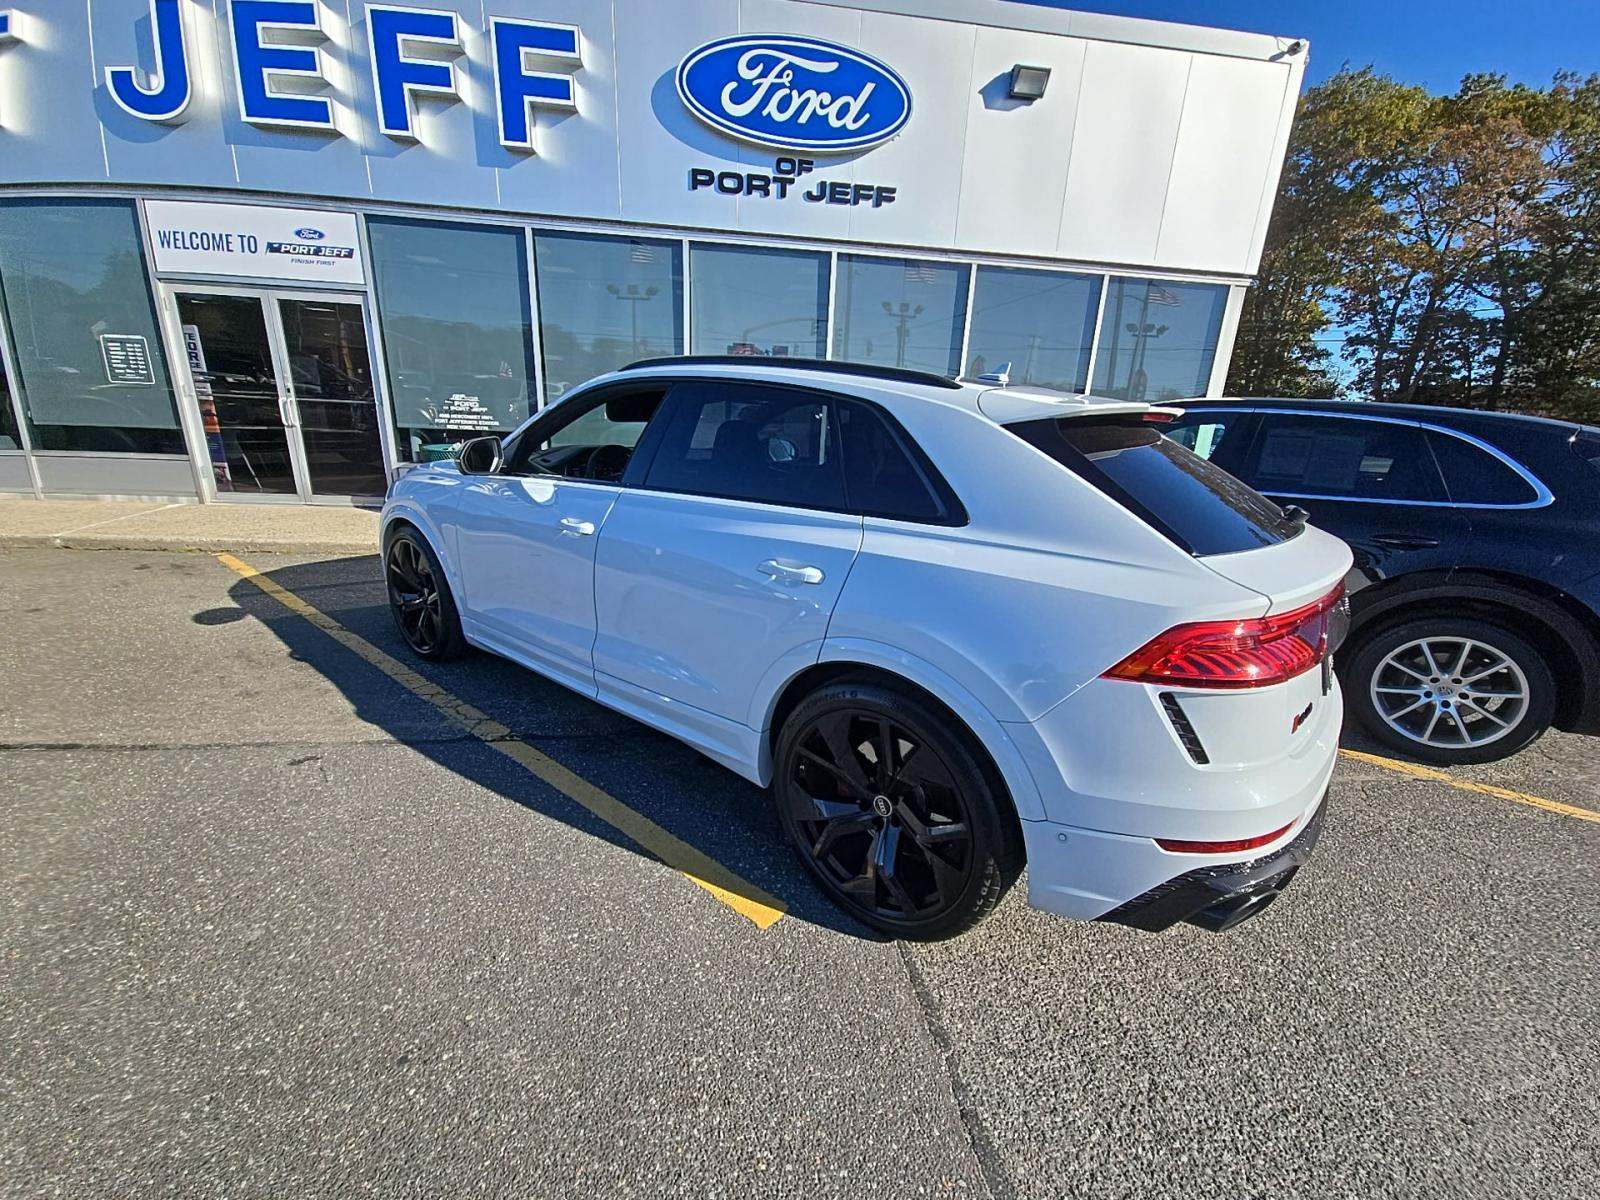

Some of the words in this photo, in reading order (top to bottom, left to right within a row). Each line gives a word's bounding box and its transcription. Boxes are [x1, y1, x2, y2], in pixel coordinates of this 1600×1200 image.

[104, 0, 580, 148] JEFF
[720, 48, 877, 131] Ford
[775, 156, 814, 177] OF
[688, 167, 796, 200] PORT
[803, 180, 898, 209] JEFF
[158, 229, 233, 253] WELCOME
[238, 234, 258, 254] TO
[280, 243, 317, 255] PORT
[318, 246, 350, 258] JEFF
